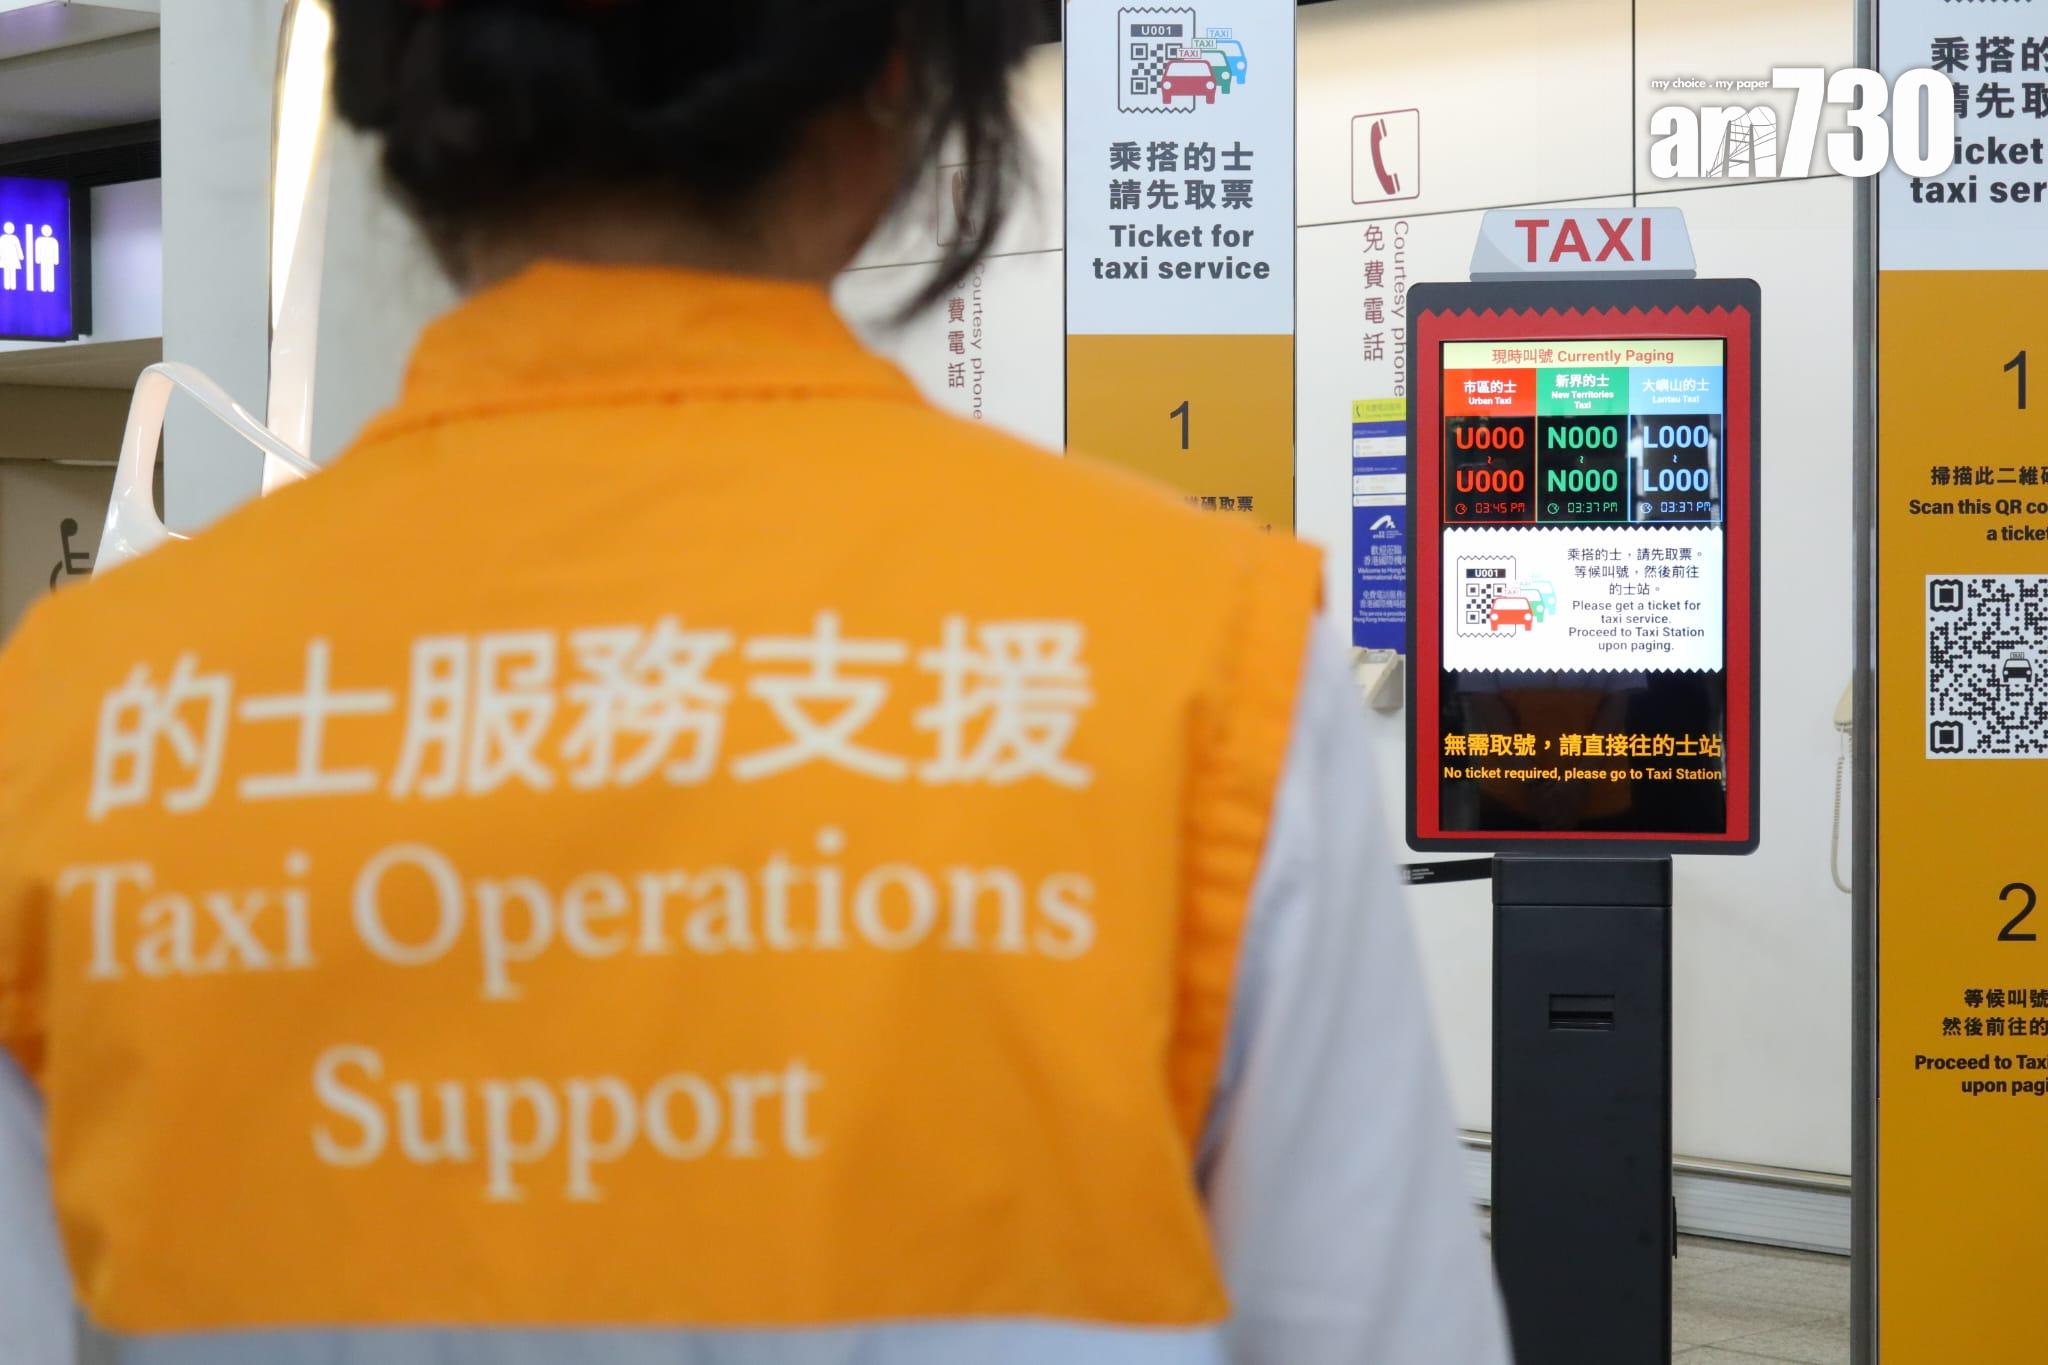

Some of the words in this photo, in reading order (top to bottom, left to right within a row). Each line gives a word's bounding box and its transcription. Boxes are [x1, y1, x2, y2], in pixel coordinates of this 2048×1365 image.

[1141, 25, 1173, 36] U001
[1209, 29, 1230, 38] TAXI
[1193, 38, 1214, 48] TAXI
[1178, 49, 1199, 58] TAXI
[1931, 36, 2048, 73] 乘搭的
[1109, 141, 1254, 172] 乘搭的士
[1954, 136, 2043, 164] icket
[1109, 179, 1254, 210] 請先取票
[1910, 175, 1977, 203] taxi
[1109, 223, 1204, 248] Ticket
[1212, 223, 1254, 248] for
[1515, 218, 1652, 262] TAXI
[1093, 256, 1149, 279] taxi
[1158, 256, 1270, 279] service
[1391, 221, 1409, 319] Courtesy
[1363, 224, 1385, 361] 免費電話
[1391, 327, 1407, 398] phone
[1492, 349, 1553, 364] 現時叫號
[1558, 350, 1621, 365] Currently
[1626, 349, 1674, 364] Paging
[970, 357, 985, 420] phone
[1464, 380, 1517, 394] 市區的士
[1555, 373, 1610, 388] 新界的士
[2004, 350, 2026, 409] 1
[1469, 396, 1493, 405] Urban
[1495, 396, 1512, 405] Taxi
[1552, 391, 1569, 399] New
[1571, 390, 1614, 399] Territories
[1682, 395, 1699, 404] Taxi
[1575, 401, 1591, 409] Taxi
[1170, 401, 1189, 449] 1
[1456, 426, 1524, 449] U000
[1548, 426, 1618, 449] N000
[1643, 425, 1708, 449] L000
[1456, 469, 1524, 493] U000
[1548, 469, 1618, 492] N000
[1643, 469, 1708, 492] L000
[1475, 503, 1507, 513] 03:45
[1510, 503, 1525, 513] PM
[1567, 502, 1600, 513] 03:37
[1603, 502, 1618, 512] PM
[1660, 502, 1693, 512] 03:37
[1696, 501, 1711, 512] PM
[1909, 499, 1953, 514] Scan
[1958, 499, 1991, 514] this
[1996, 499, 2022, 516] QR
[1986, 528, 1997, 541] a
[1475, 569, 1499, 578] U001
[1573, 600, 1614, 611] Please
[1616, 602, 1634, 613] get
[1638, 603, 1645, 611] a
[1648, 600, 1681, 611] ticket
[1684, 600, 1701, 611] for
[1601, 613, 1622, 624] taxi
[1626, 613, 1672, 624] service.
[1569, 627, 1617, 637] Proceed
[1621, 628, 1632, 637] to
[1635, 627, 1659, 637] Taxi
[1662, 627, 1705, 637] Station
[1598, 643, 1627, 652] upon
[1631, 641, 1674, 653] paging.
[87, 613, 1094, 819] 的士服務支援
[1444, 733, 1722, 757] 無需取號，請直接往的士站
[1444, 767, 1461, 778] No
[1465, 767, 1501, 779] ticket
[1504, 767, 1561, 781] required,
[1564, 767, 1606, 782] please
[1611, 770, 1626, 782] go
[1630, 769, 1643, 779] to
[1646, 767, 1672, 779] Taxi
[1676, 768, 1722, 780] Station
[58, 849, 317, 982] Taxi
[350, 827, 1096, 1001] Operations
[1997, 882, 2037, 941] 2
[1964, 988, 2048, 1008] 等候叫號
[1943, 1017, 2048, 1036] 然後前往的
[1915, 1054, 1990, 1070] Proceed
[1994, 1056, 2012, 1070] to
[1962, 1080, 2007, 1096] upon
[310, 1044, 824, 1202] Support
